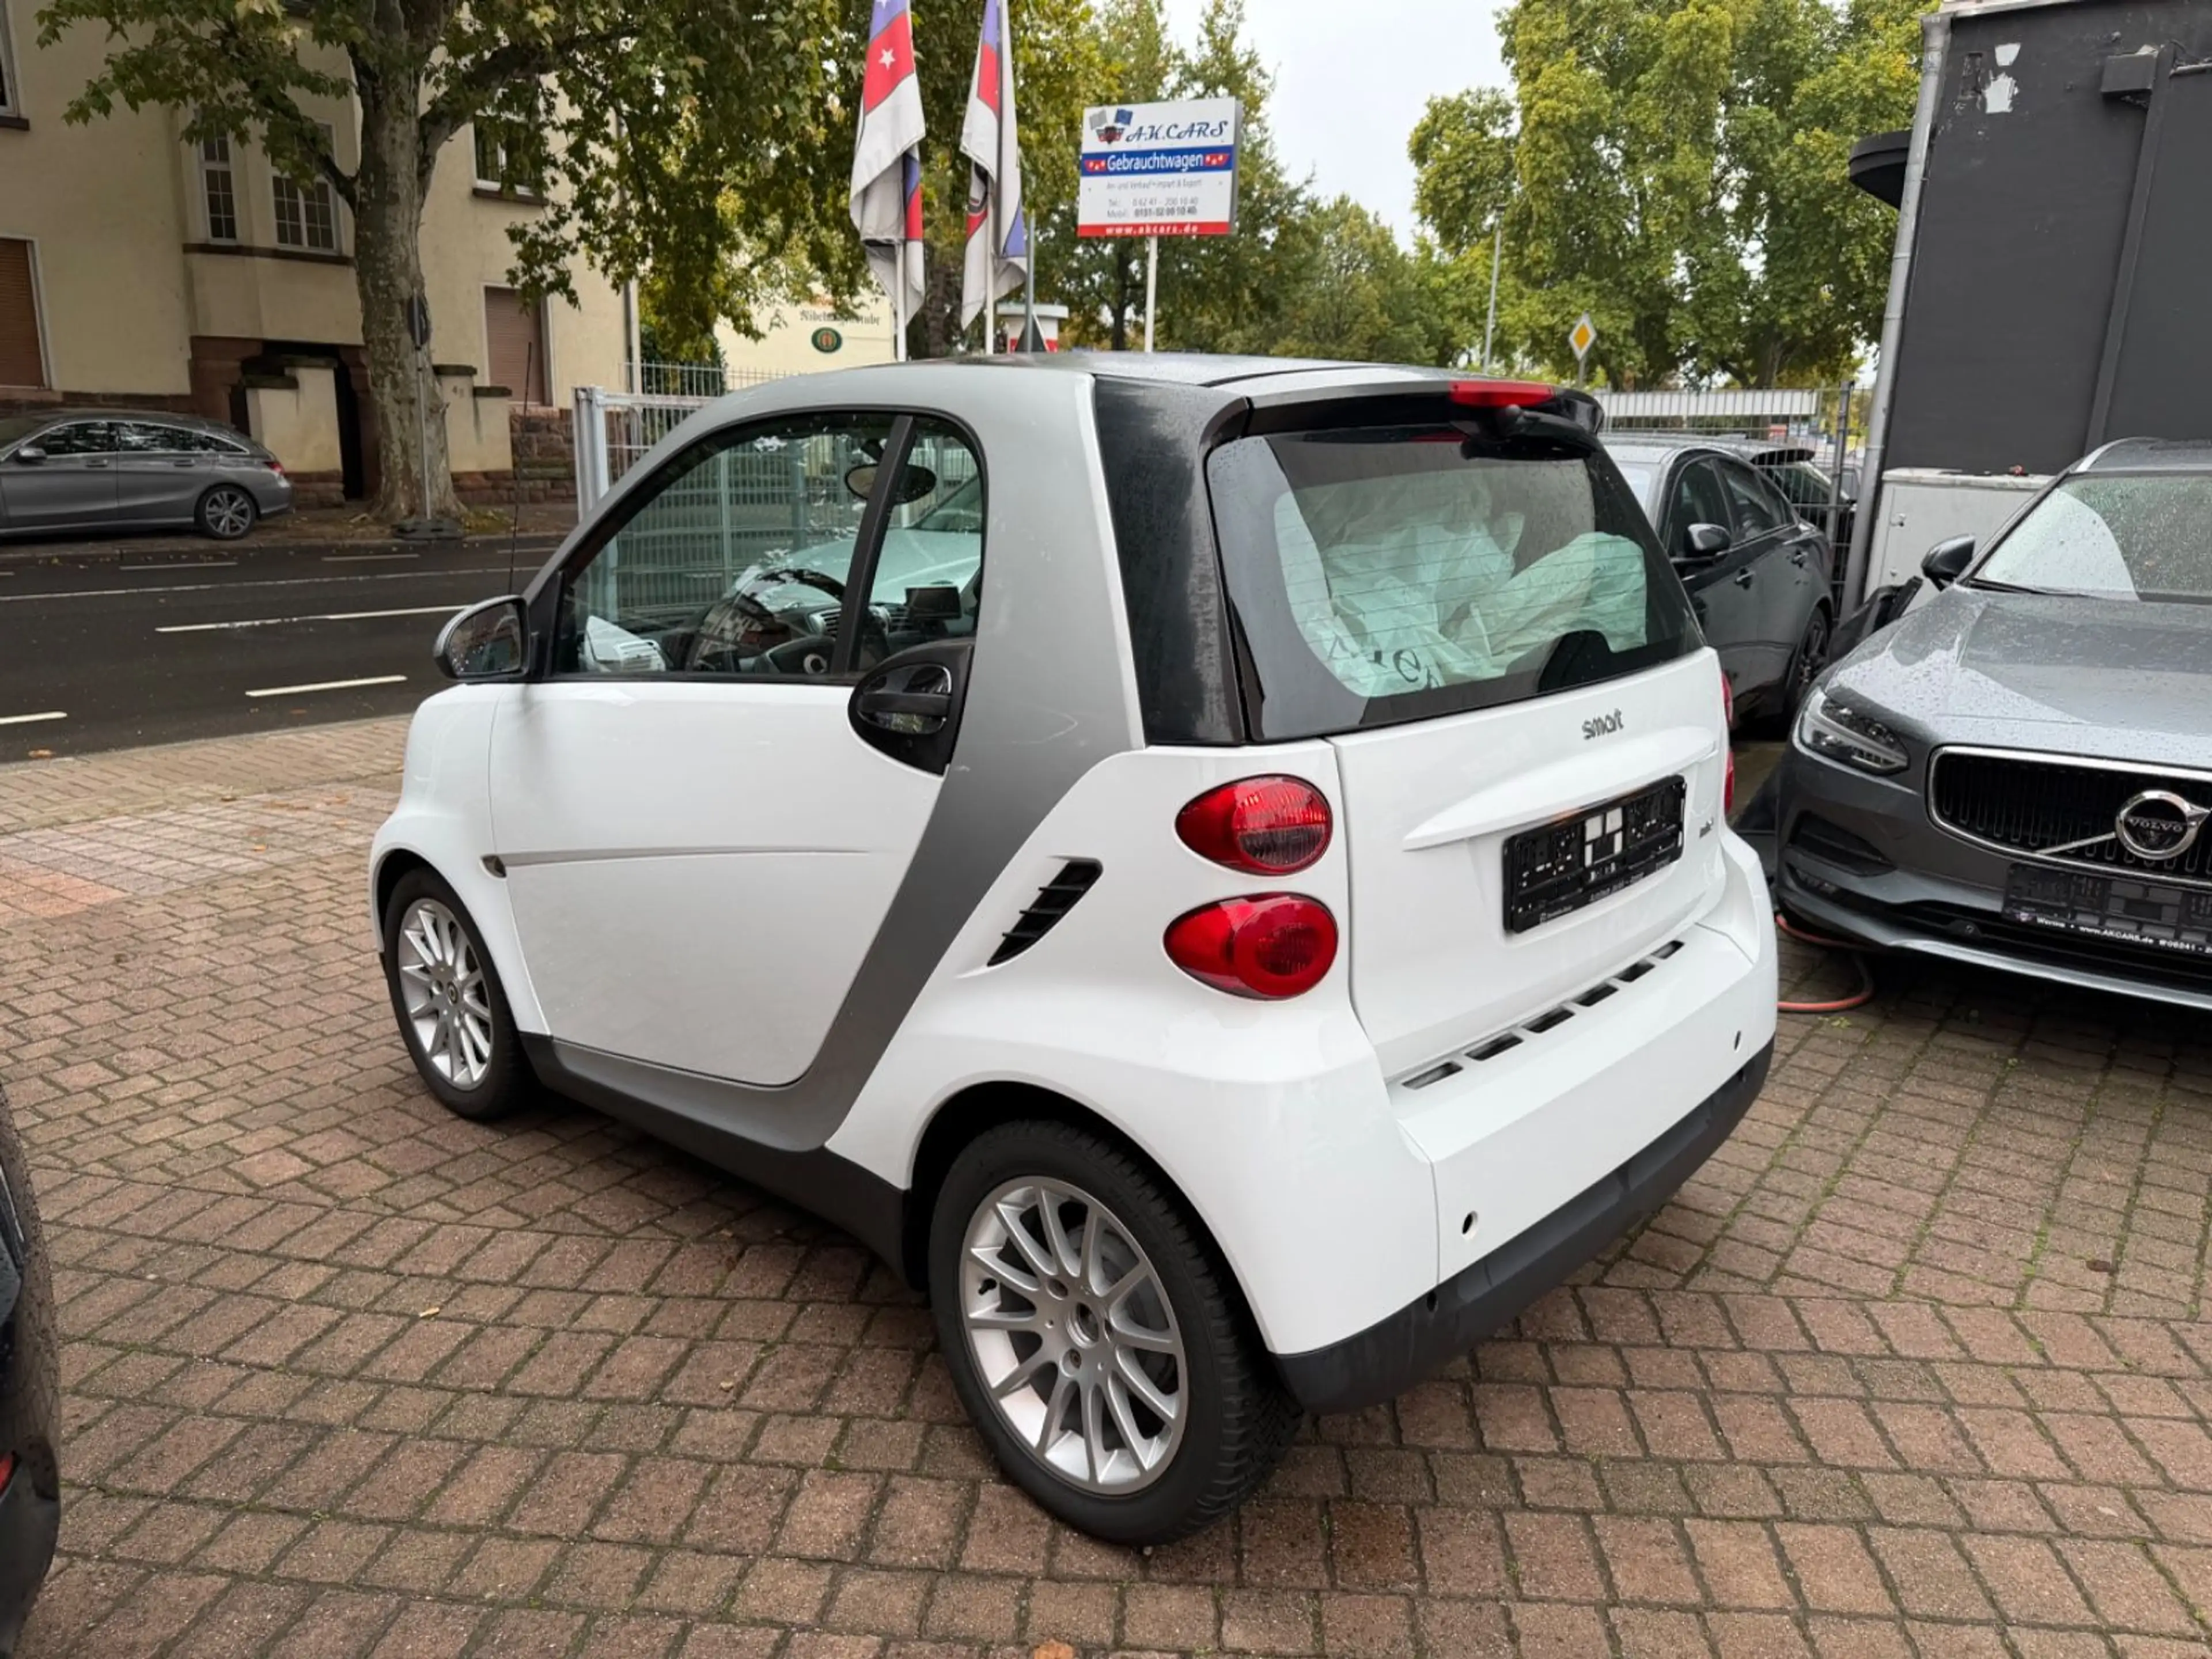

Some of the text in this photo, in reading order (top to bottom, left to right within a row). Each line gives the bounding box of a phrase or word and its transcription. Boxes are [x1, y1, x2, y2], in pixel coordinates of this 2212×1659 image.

[1107, 152, 1203, 172] Gebrauchtwagen
[1106, 224, 1198, 235] www.akcars.de
[1581, 708, 1624, 740] smart
[2129, 818, 2183, 832] VOLVO
